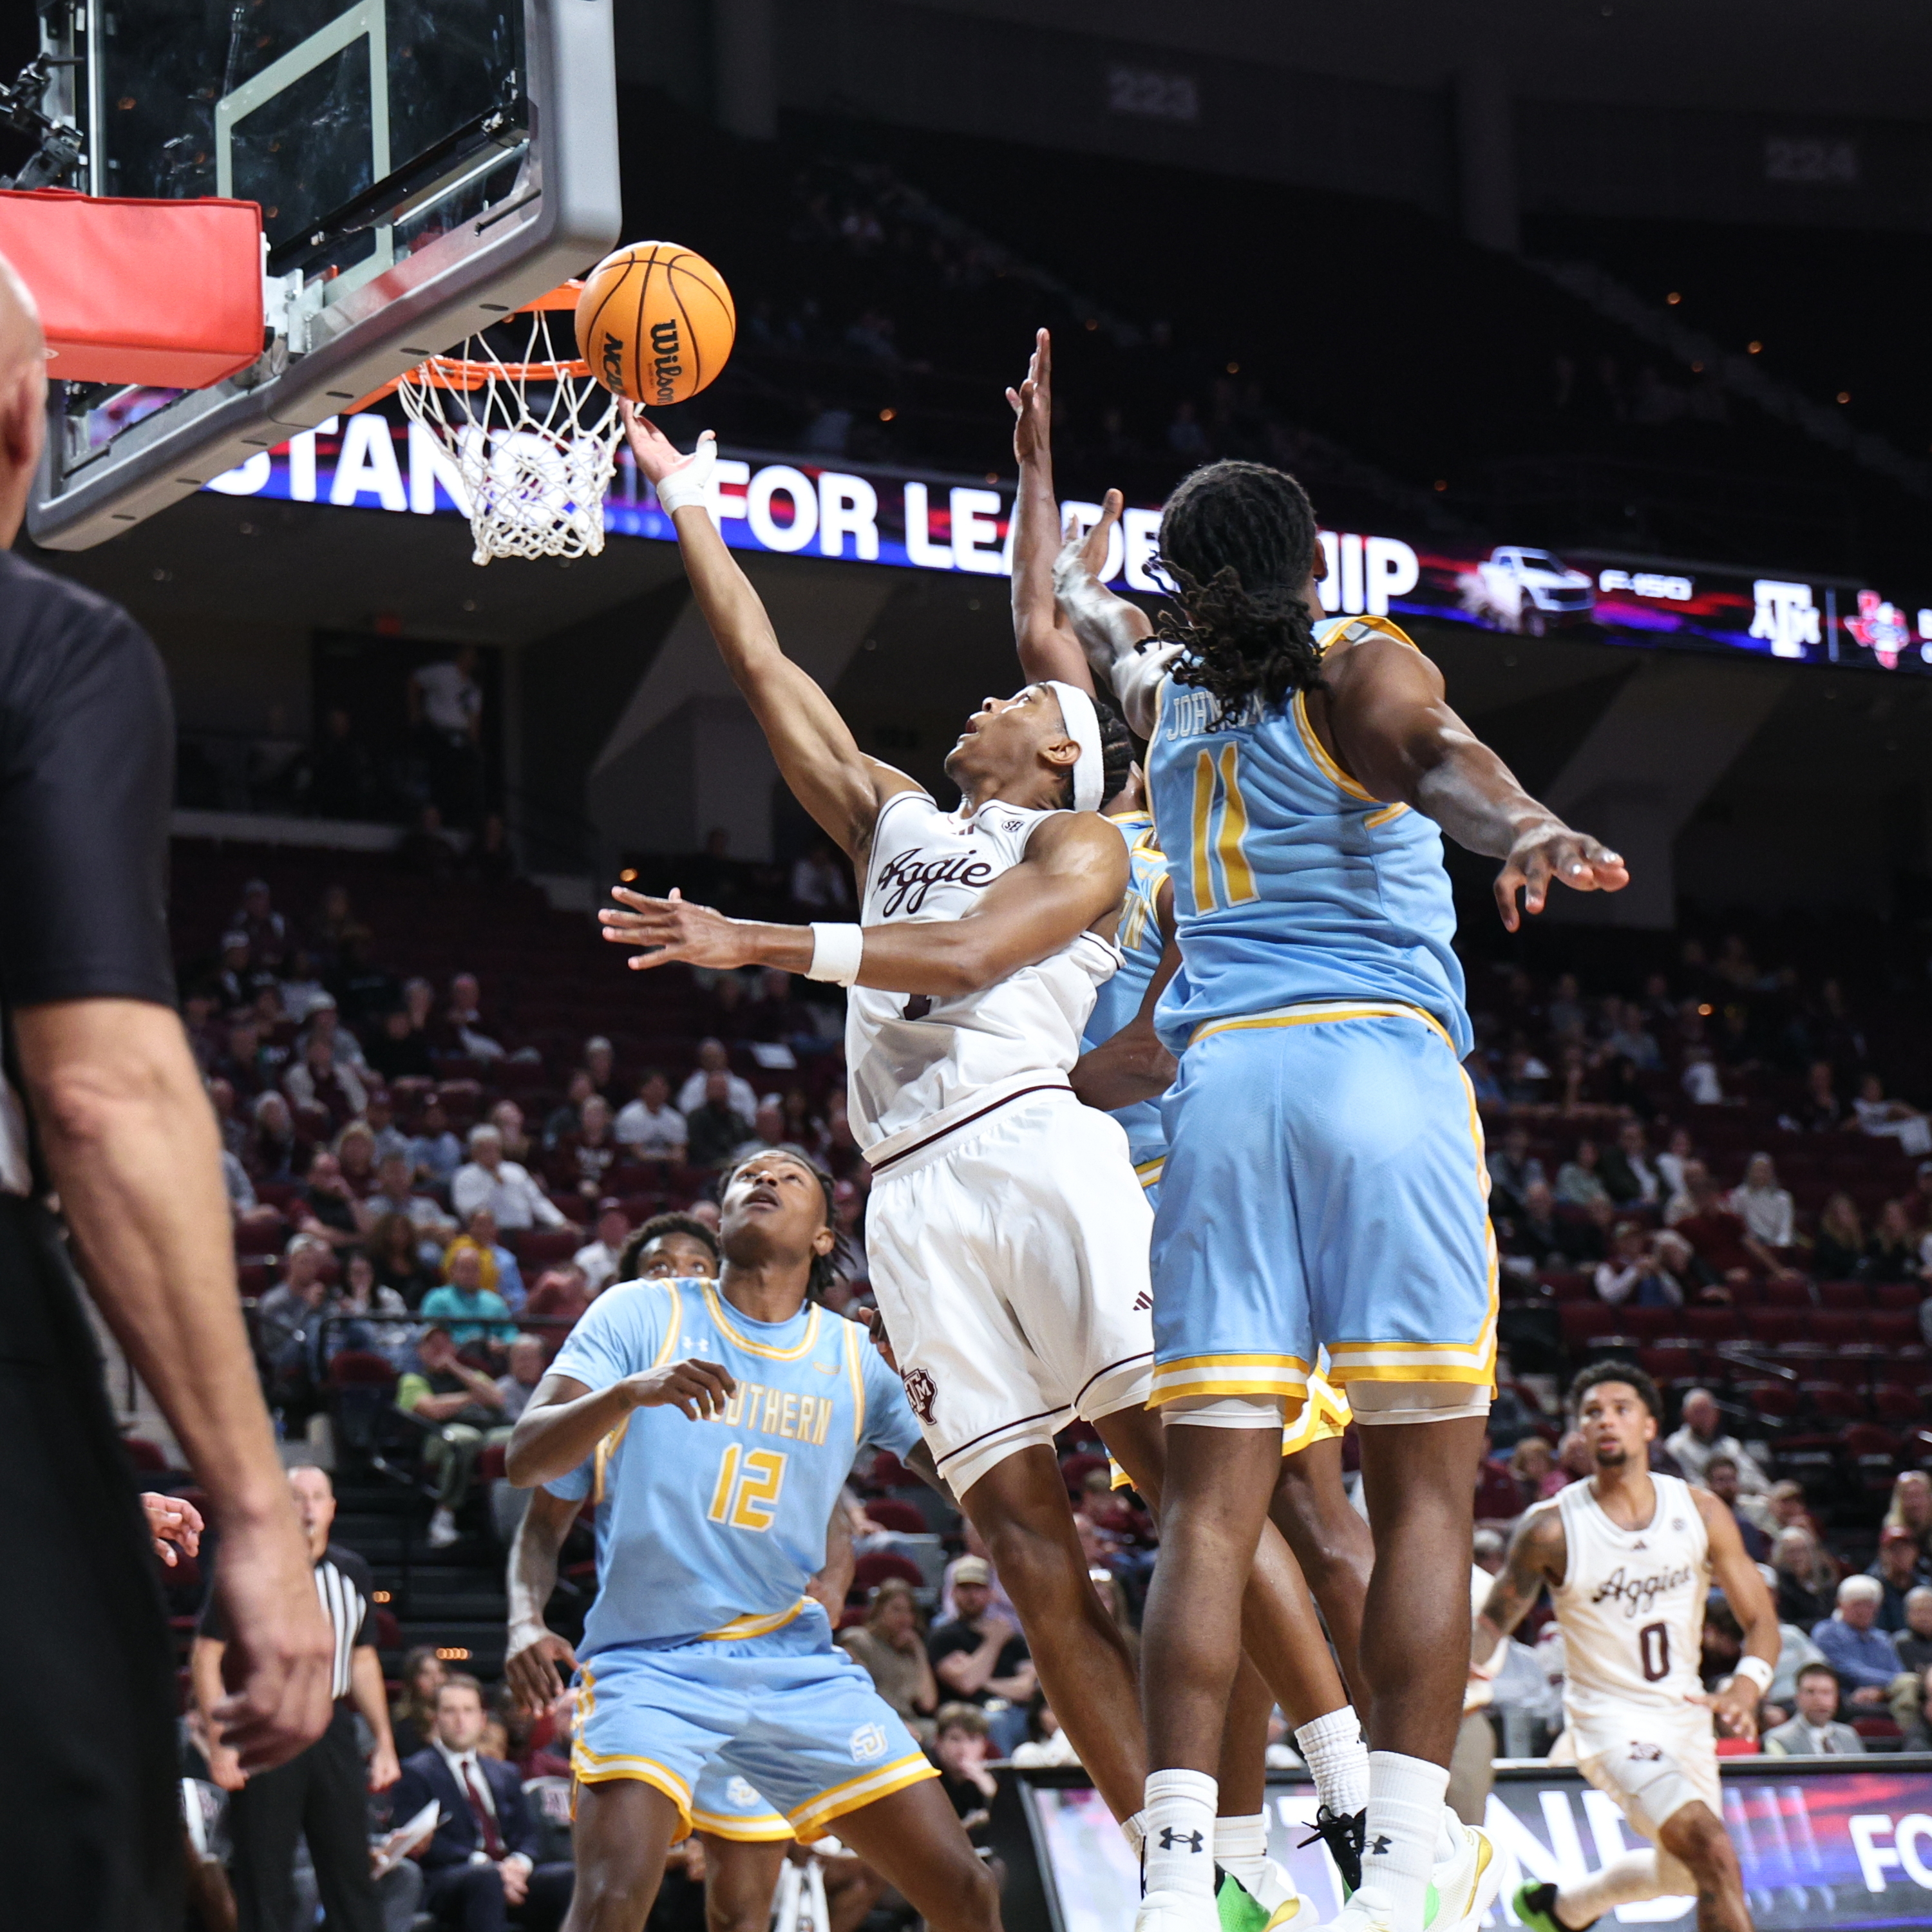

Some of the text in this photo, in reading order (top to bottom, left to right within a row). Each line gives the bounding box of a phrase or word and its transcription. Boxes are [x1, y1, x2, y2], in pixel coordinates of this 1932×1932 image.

[650, 319, 683, 404] Wilson
[704, 459, 879, 562] FOR
[904, 482, 1419, 617] LEDEIP
[1191, 741, 1260, 917] 11
[696, 1379, 833, 1447] UTHERN
[707, 1442, 789, 1533] 12
[1640, 1622, 1671, 1682] 0
